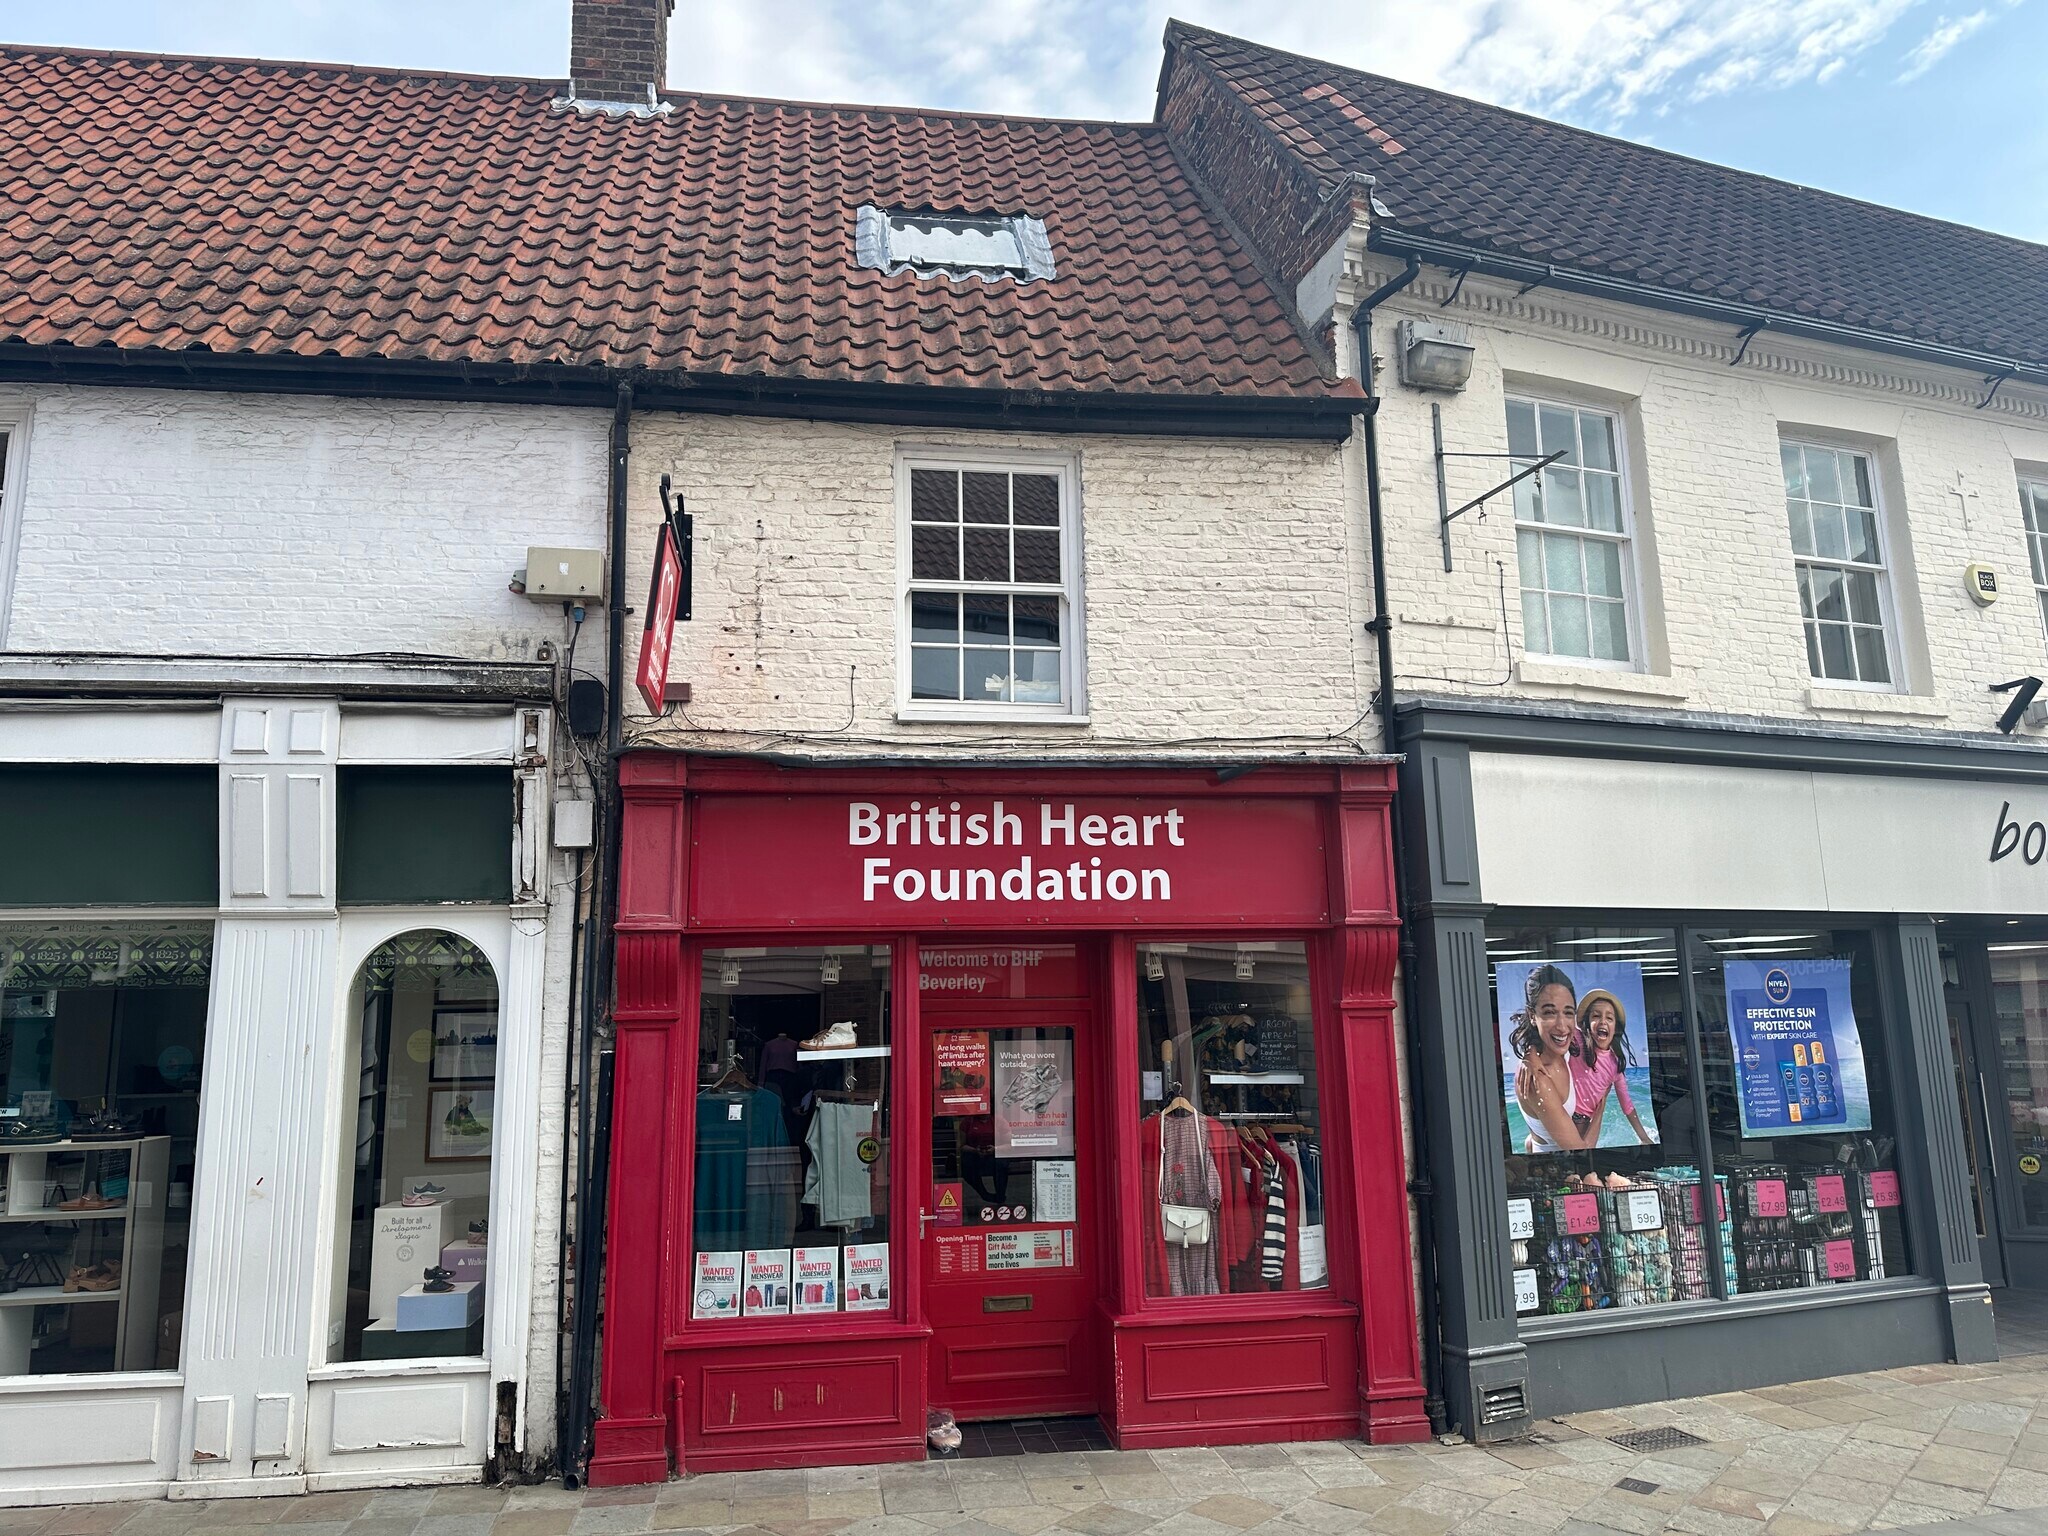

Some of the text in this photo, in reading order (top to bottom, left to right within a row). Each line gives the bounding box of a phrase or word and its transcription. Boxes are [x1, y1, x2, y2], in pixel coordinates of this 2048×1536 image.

[1980, 579, 1995, 588] BOX
[849, 801, 1185, 846] British Heart
[863, 856, 1171, 901] Foundation
[37, 950, 179, 961] 1825 1825 1825
[919, 950, 1043, 967] Welcome to BHF
[372, 957, 395, 967] 1825
[4, 978, 28, 989] 1825
[919, 973, 986, 992] Beverley
[1768, 980, 1788, 988] NIVEA
[1746, 1007, 1816, 1019] EFFECTIVE SUN
[1753, 1020, 1812, 1031] PROTECTION
[1766, 1032, 1788, 1040] EXPERT
[1000, 1052, 1020, 1060] What
[1021, 1052, 1036, 1060] you
[957, 1058, 986, 1068] surgery?
[1761, 1201, 1785, 1212] £7.99
[1821, 1196, 1846, 1207] £2.49
[391, 1217, 406, 1225] Built
[1570, 1215, 1598, 1228] £1.49
[1637, 1213, 1656, 1225] 59p
[381, 1224, 432, 1233] Development
[936, 1235, 963, 1243] Opening
[988, 1243, 1000, 1251] Gift
[1001, 1252, 1014, 1260] help
[800, 1262, 832, 1271] WANTED
[851, 1258, 882, 1268] WANTED
[988, 1260, 1020, 1269] more lives
[1833, 1261, 1850, 1273] 99p
[702, 1267, 735, 1275] WANTED
[751, 1264, 783, 1273] WANTED
[751, 1272, 784, 1280] MENSWEAR
